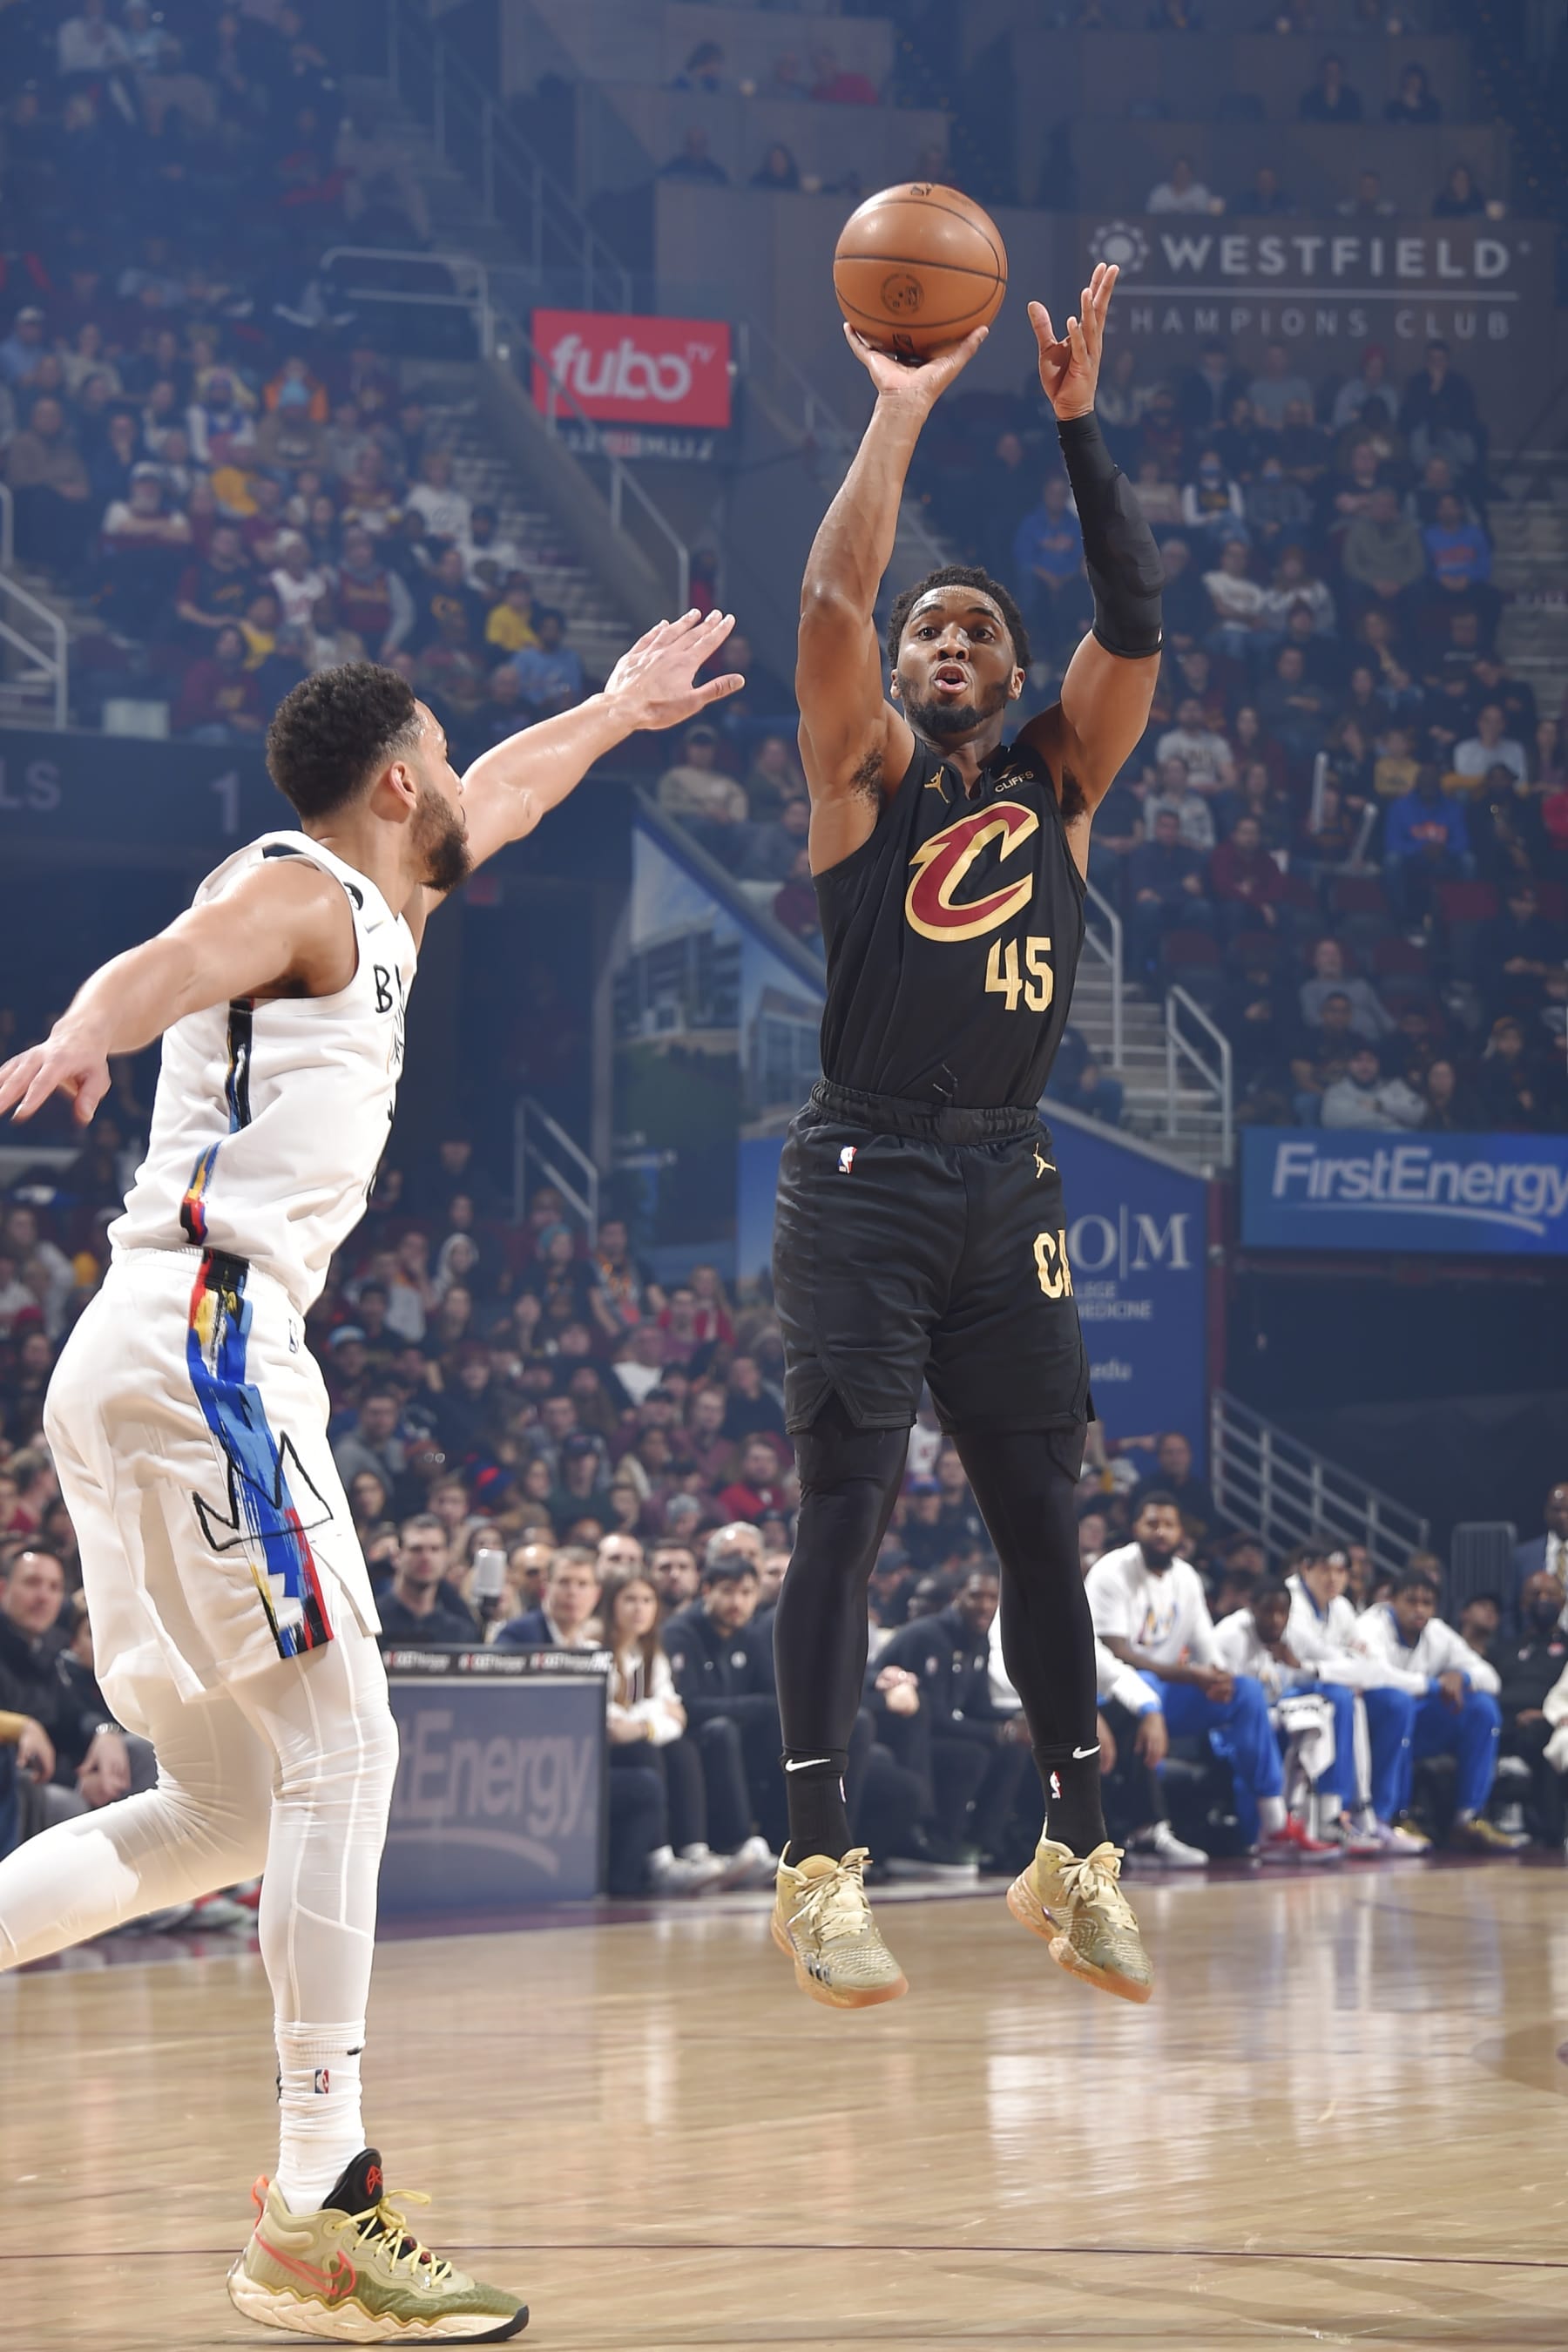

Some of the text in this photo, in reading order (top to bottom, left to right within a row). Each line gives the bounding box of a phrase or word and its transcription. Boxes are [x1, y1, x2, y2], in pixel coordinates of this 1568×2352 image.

[1159, 233, 1511, 278] WESTFIELD
[1395, 309, 1509, 339] CLUB
[994, 770, 1034, 793] CLIFFS
[984, 936, 1054, 1012] 45
[1272, 1142, 1568, 1217] FirstEnergy
